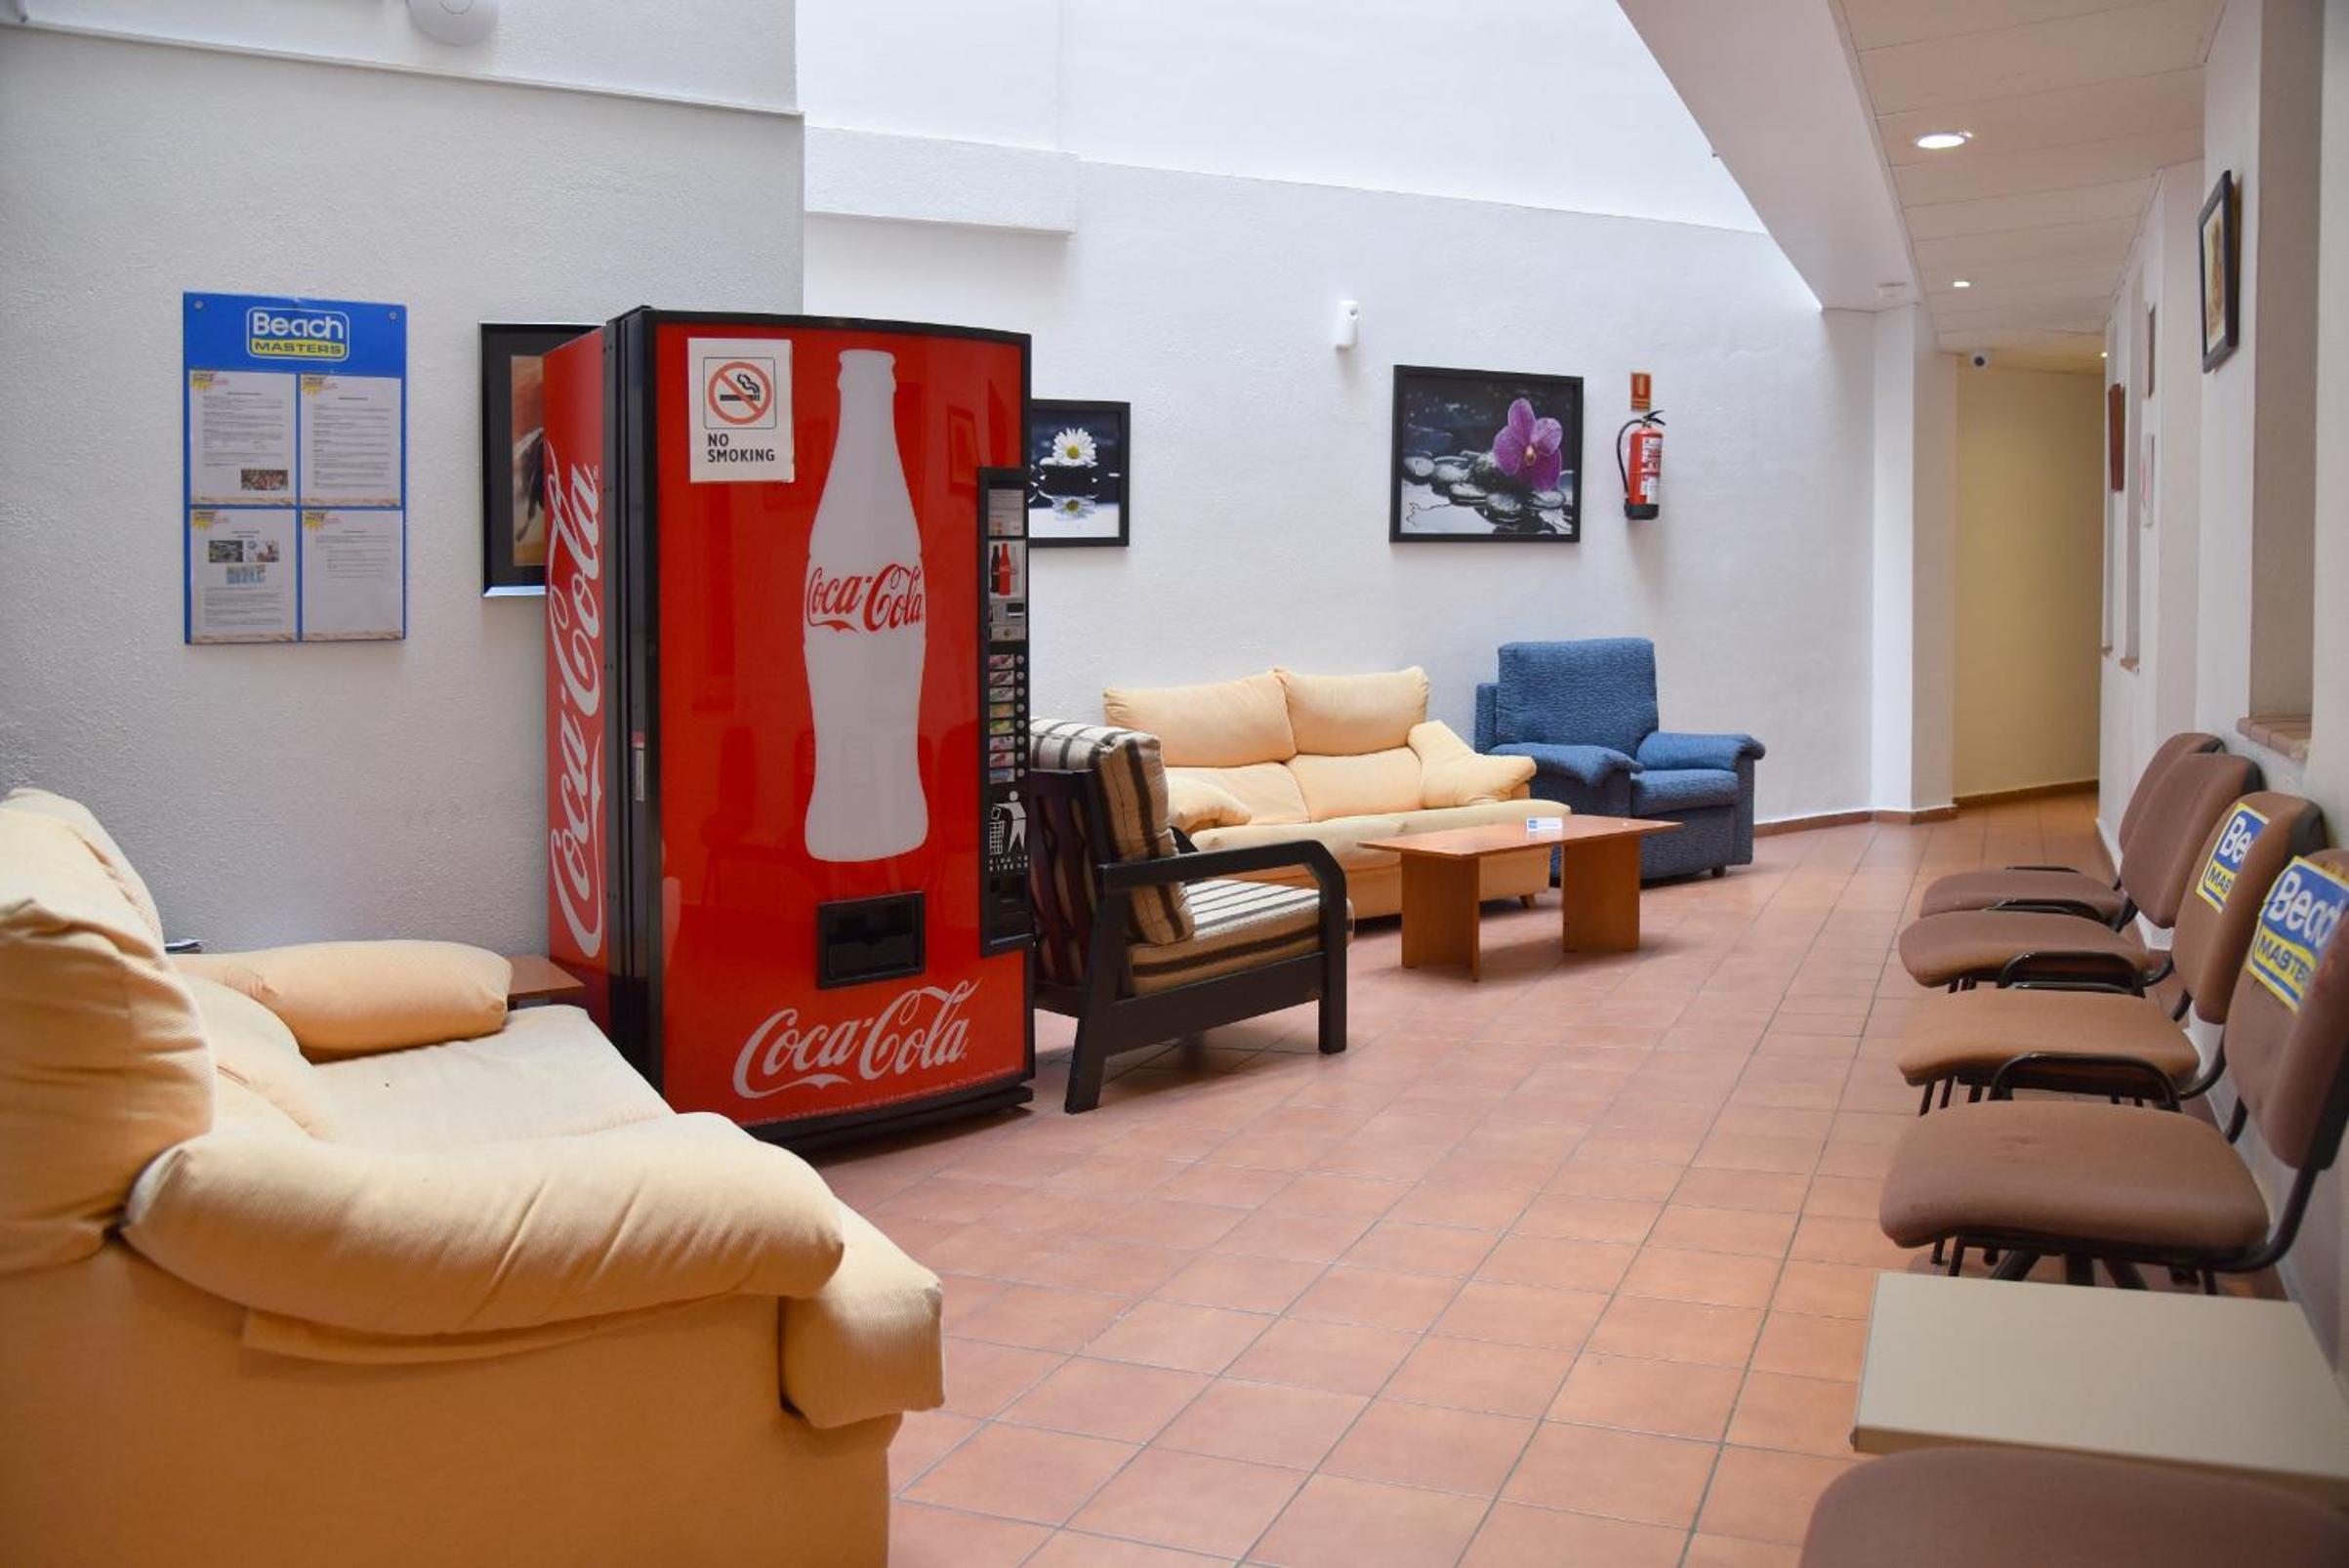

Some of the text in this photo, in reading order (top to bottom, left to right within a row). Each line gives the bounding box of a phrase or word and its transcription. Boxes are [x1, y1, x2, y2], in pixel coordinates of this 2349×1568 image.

[252, 311, 344, 340] Beach
[254, 341, 342, 354] MASTERS
[707, 433, 729, 447] NO
[707, 448, 775, 464] SMOKING
[806, 562, 923, 633] Coca-Cola
[547, 440, 602, 959] Coca-Cola
[2219, 815, 2253, 863] Be
[2255, 934, 2313, 985] MASTE
[732, 977, 982, 1099] Coca-Cola
